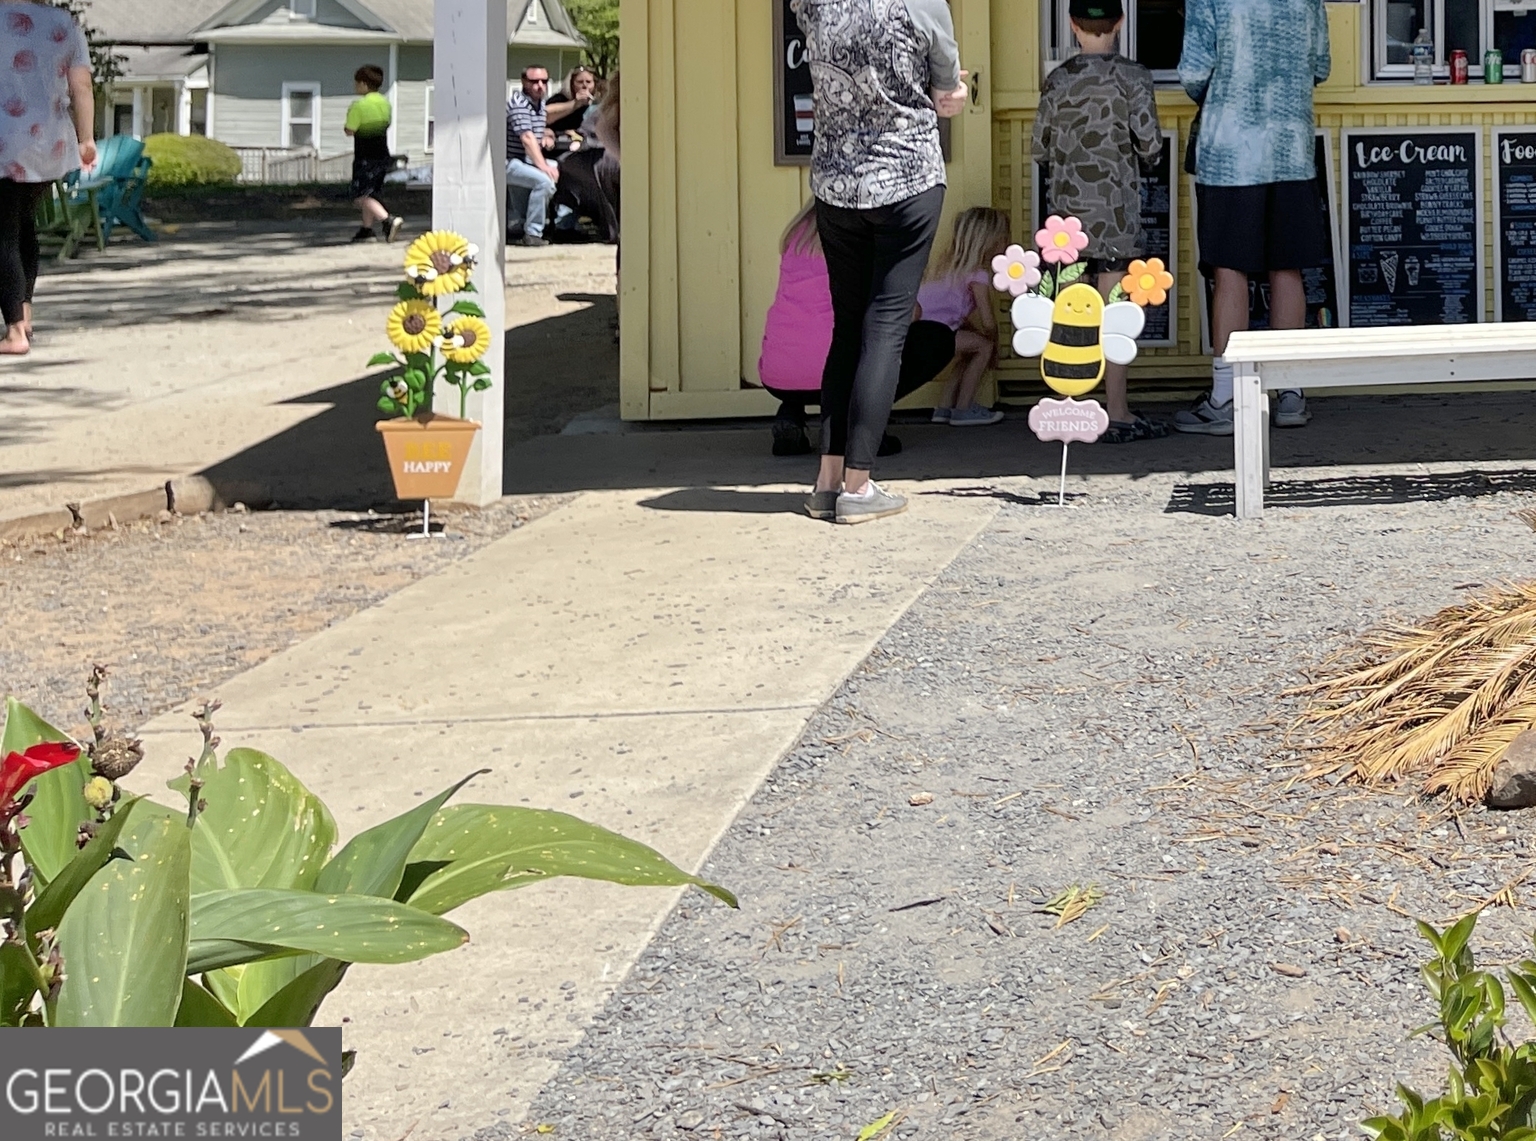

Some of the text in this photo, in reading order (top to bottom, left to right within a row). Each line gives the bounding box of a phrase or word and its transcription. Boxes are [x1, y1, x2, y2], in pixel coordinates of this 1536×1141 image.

[1355, 139, 1468, 169] Ice-Cream
[1042, 407, 1096, 420] WELCOME
[1038, 420, 1099, 432] FRIENDS
[403, 461, 452, 473] HAPPY
